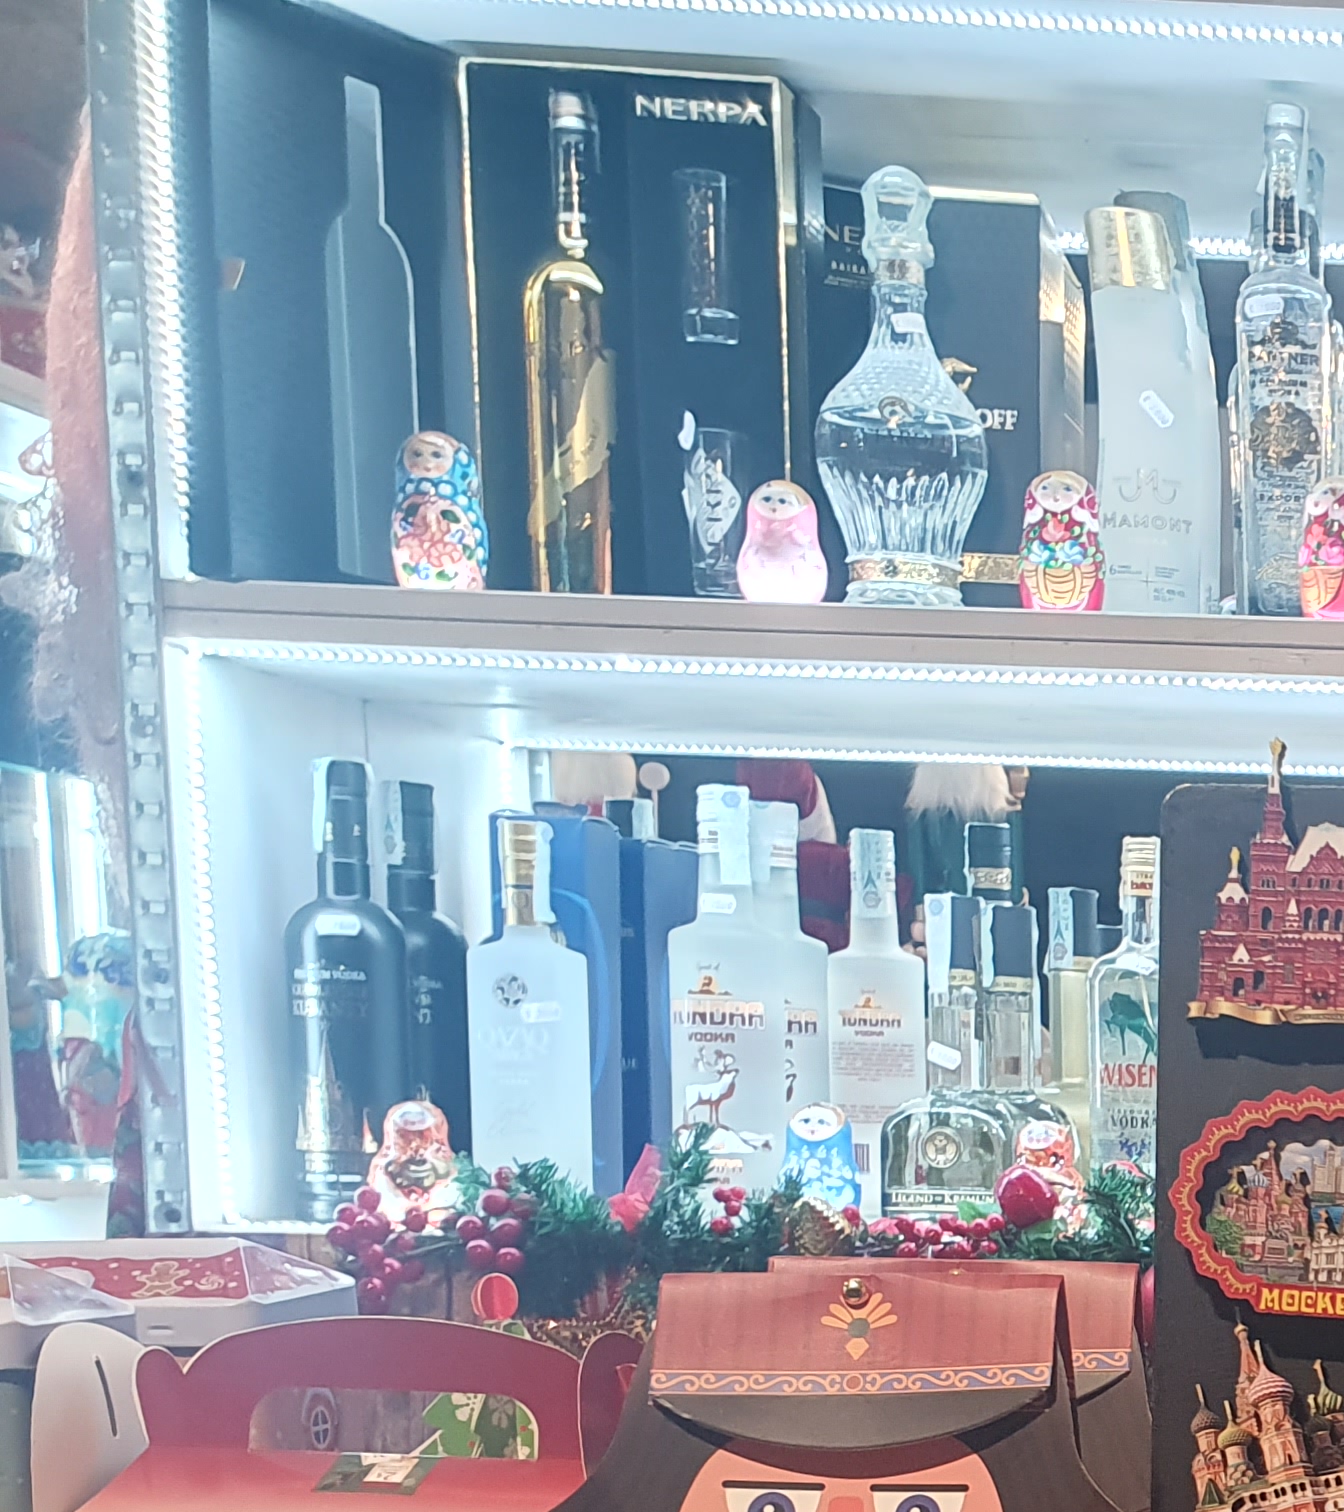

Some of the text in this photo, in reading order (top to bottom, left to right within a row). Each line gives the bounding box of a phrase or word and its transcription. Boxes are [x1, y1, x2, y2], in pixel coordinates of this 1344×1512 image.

[635, 94, 768, 126] NERPA
[977, 409, 1018, 430] OFF
[1102, 512, 1193, 534] MAMONT
[688, 1032, 736, 1043] VODKA
